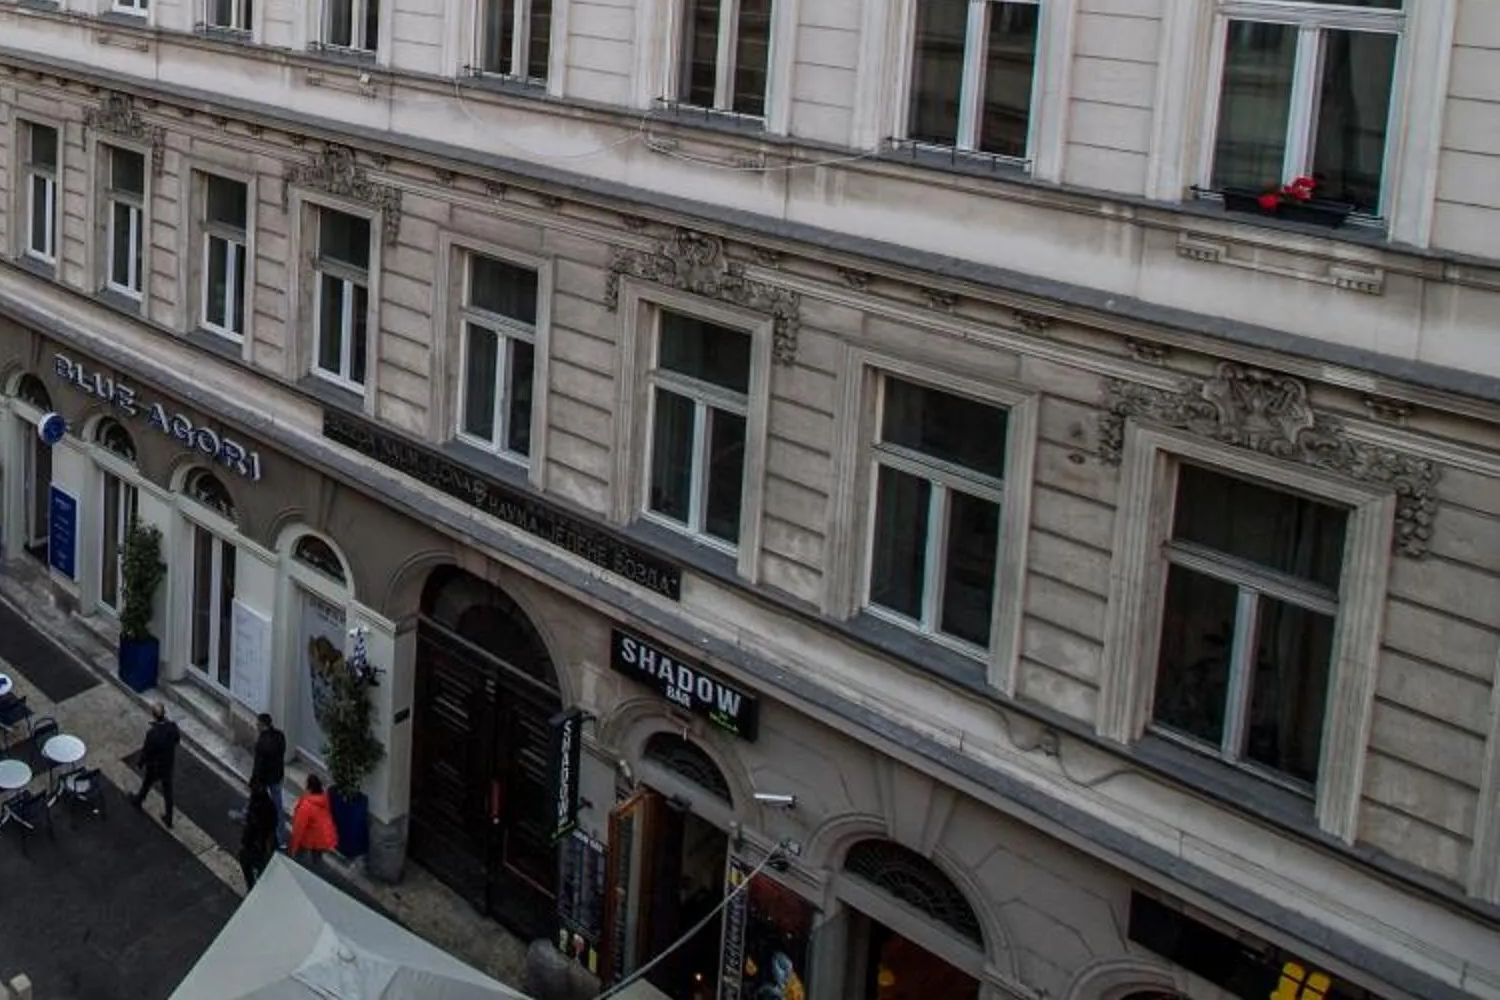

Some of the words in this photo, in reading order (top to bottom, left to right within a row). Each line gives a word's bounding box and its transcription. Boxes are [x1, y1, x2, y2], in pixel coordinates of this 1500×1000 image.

[54, 353, 136, 415] BLUE
[150, 402, 261, 481] AGORI
[621, 637, 741, 717] SHADOW
[666, 685, 691, 709] BAR
